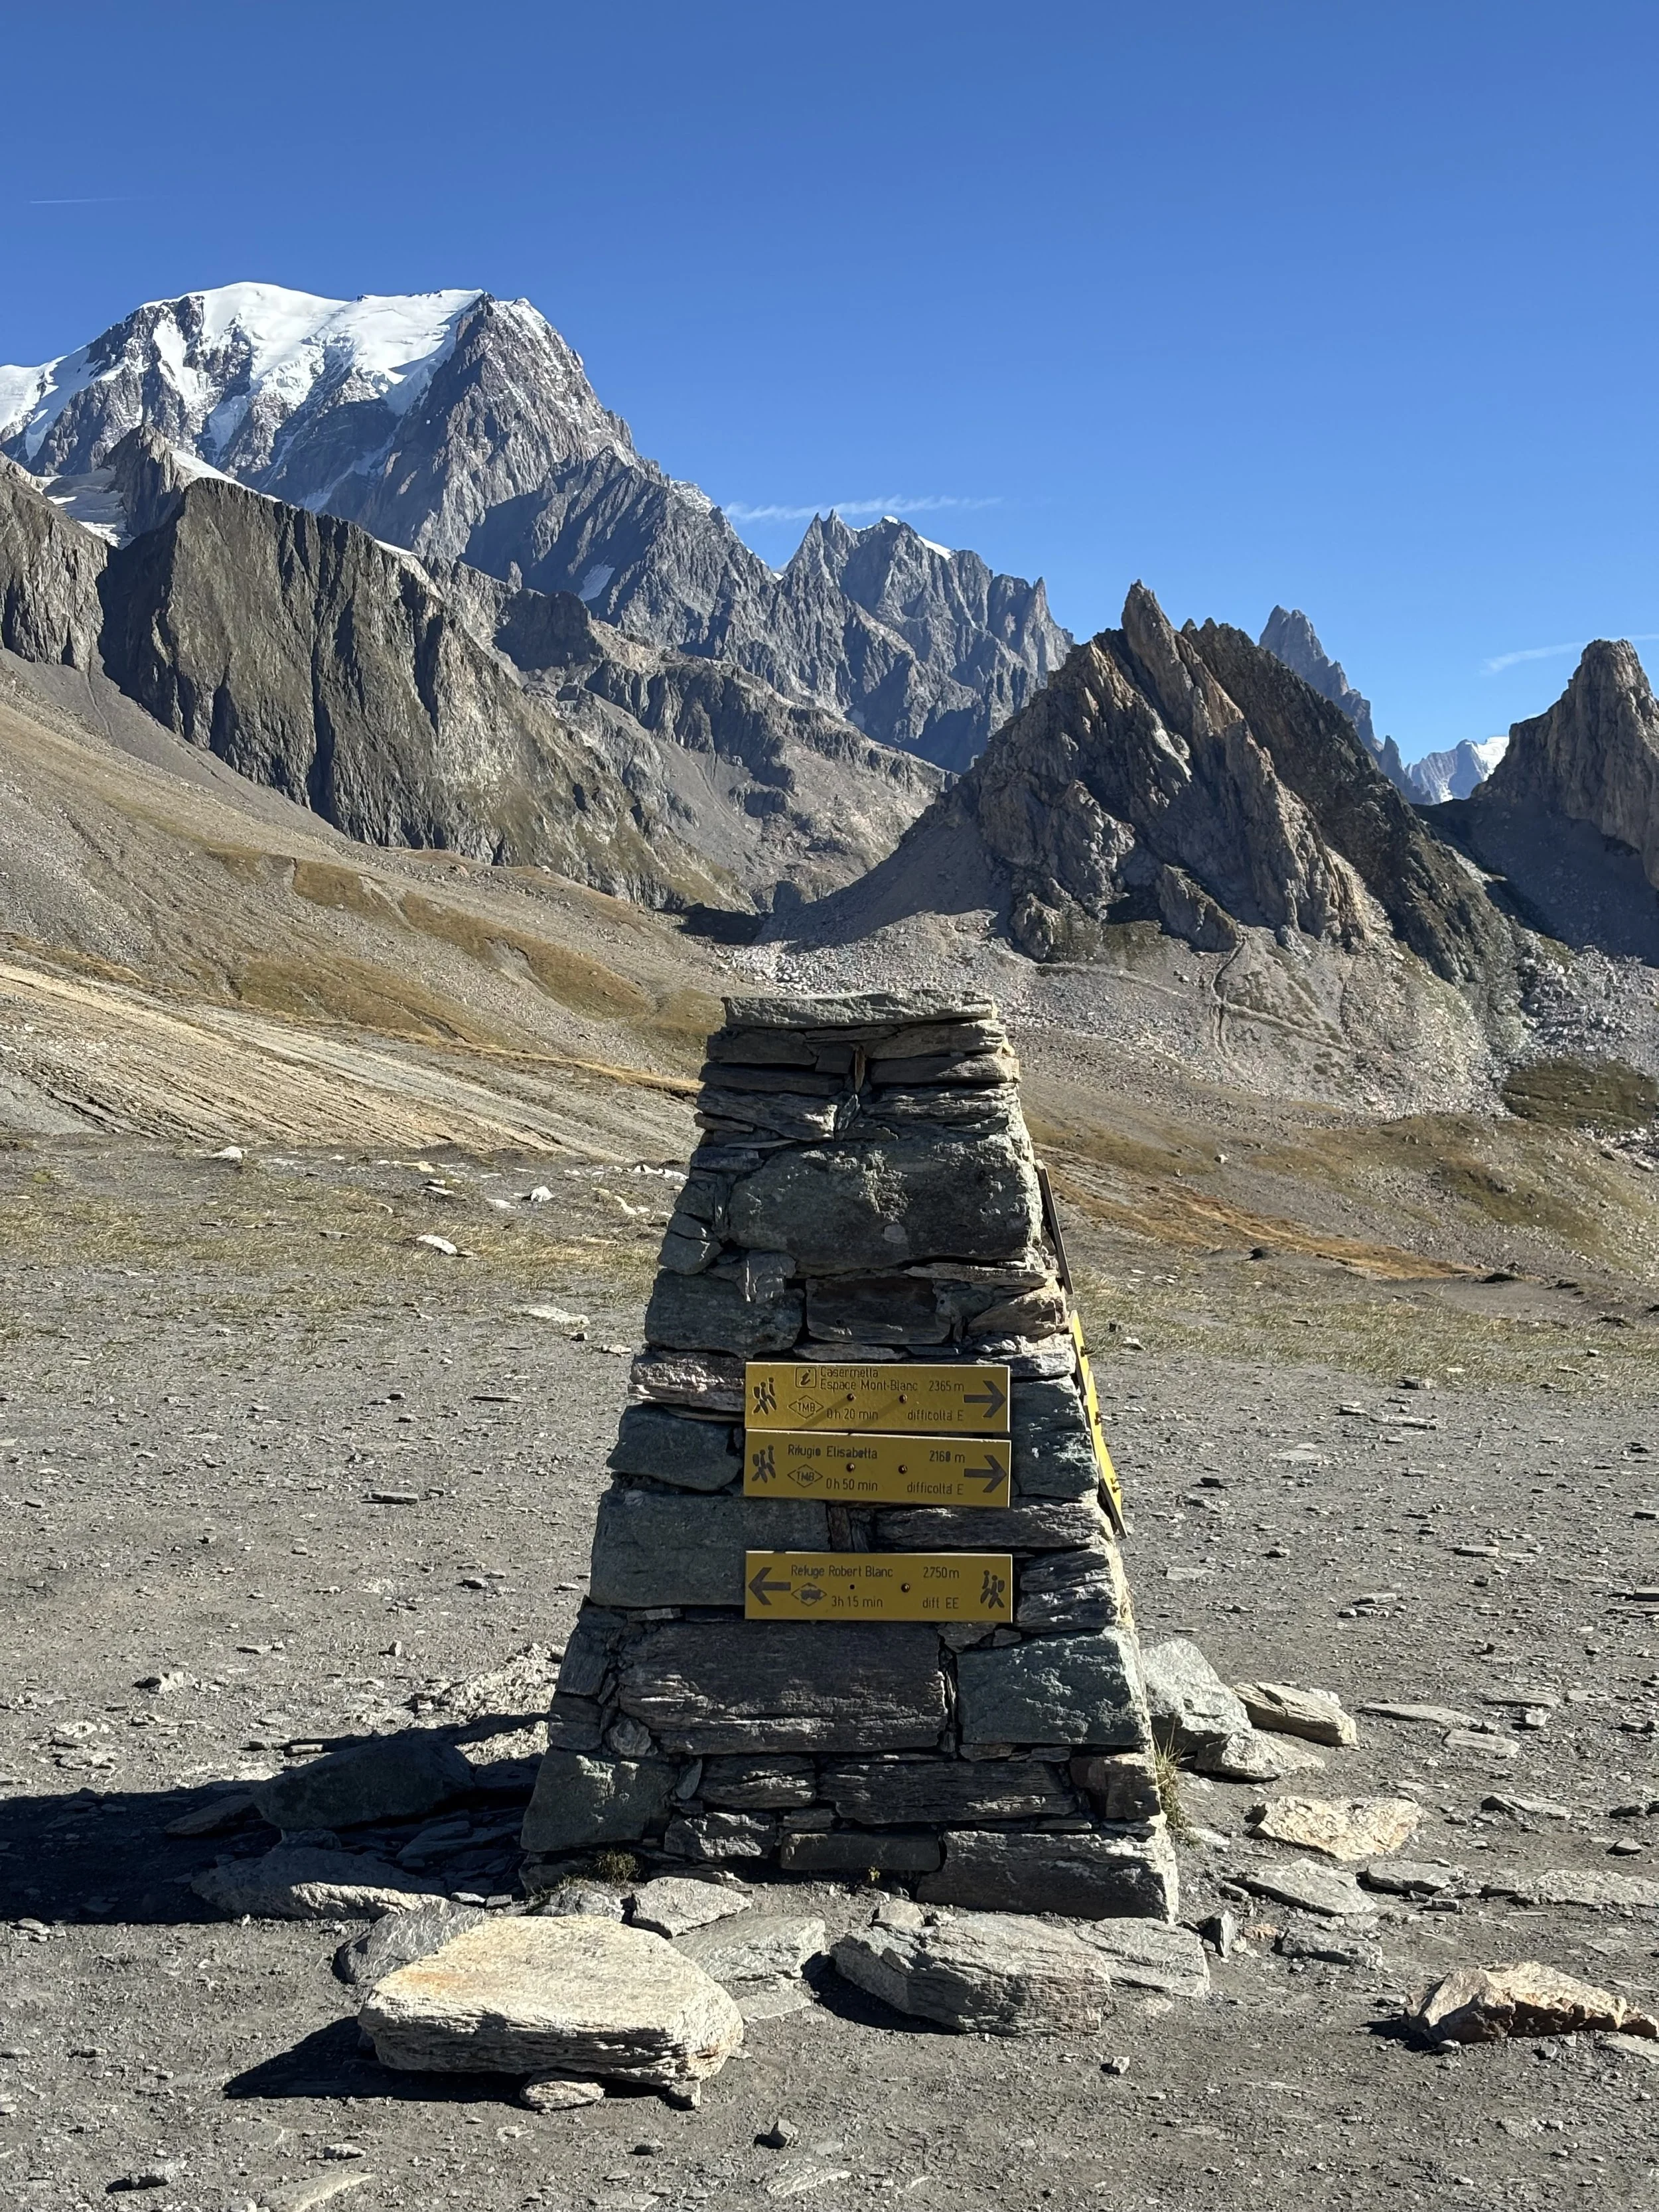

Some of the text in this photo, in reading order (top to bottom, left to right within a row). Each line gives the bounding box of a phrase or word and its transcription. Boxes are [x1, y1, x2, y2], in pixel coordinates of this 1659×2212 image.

[820, 1366, 879, 1378] Casermetta
[820, 1378, 856, 1392] Espace
[861, 1380, 918, 1392] Mont-Blanc
[797, 1402, 816, 1413] TMB
[858, 1409, 879, 1420] min
[958, 1411, 964, 1421] E
[788, 1443, 821, 1459] Rifugio
[826, 1445, 877, 1459] Elisabetta
[954, 1453, 965, 1463] m
[796, 1471, 815, 1481] TMB
[857, 1479, 878, 1491] min
[957, 1485, 964, 1495] E
[791, 1564, 825, 1579] Refuge
[828, 1565, 861, 1577] Robert
[866, 1566, 893, 1578] Blanc
[863, 1597, 883, 1607] min
[946, 1598, 959, 1609] EE
